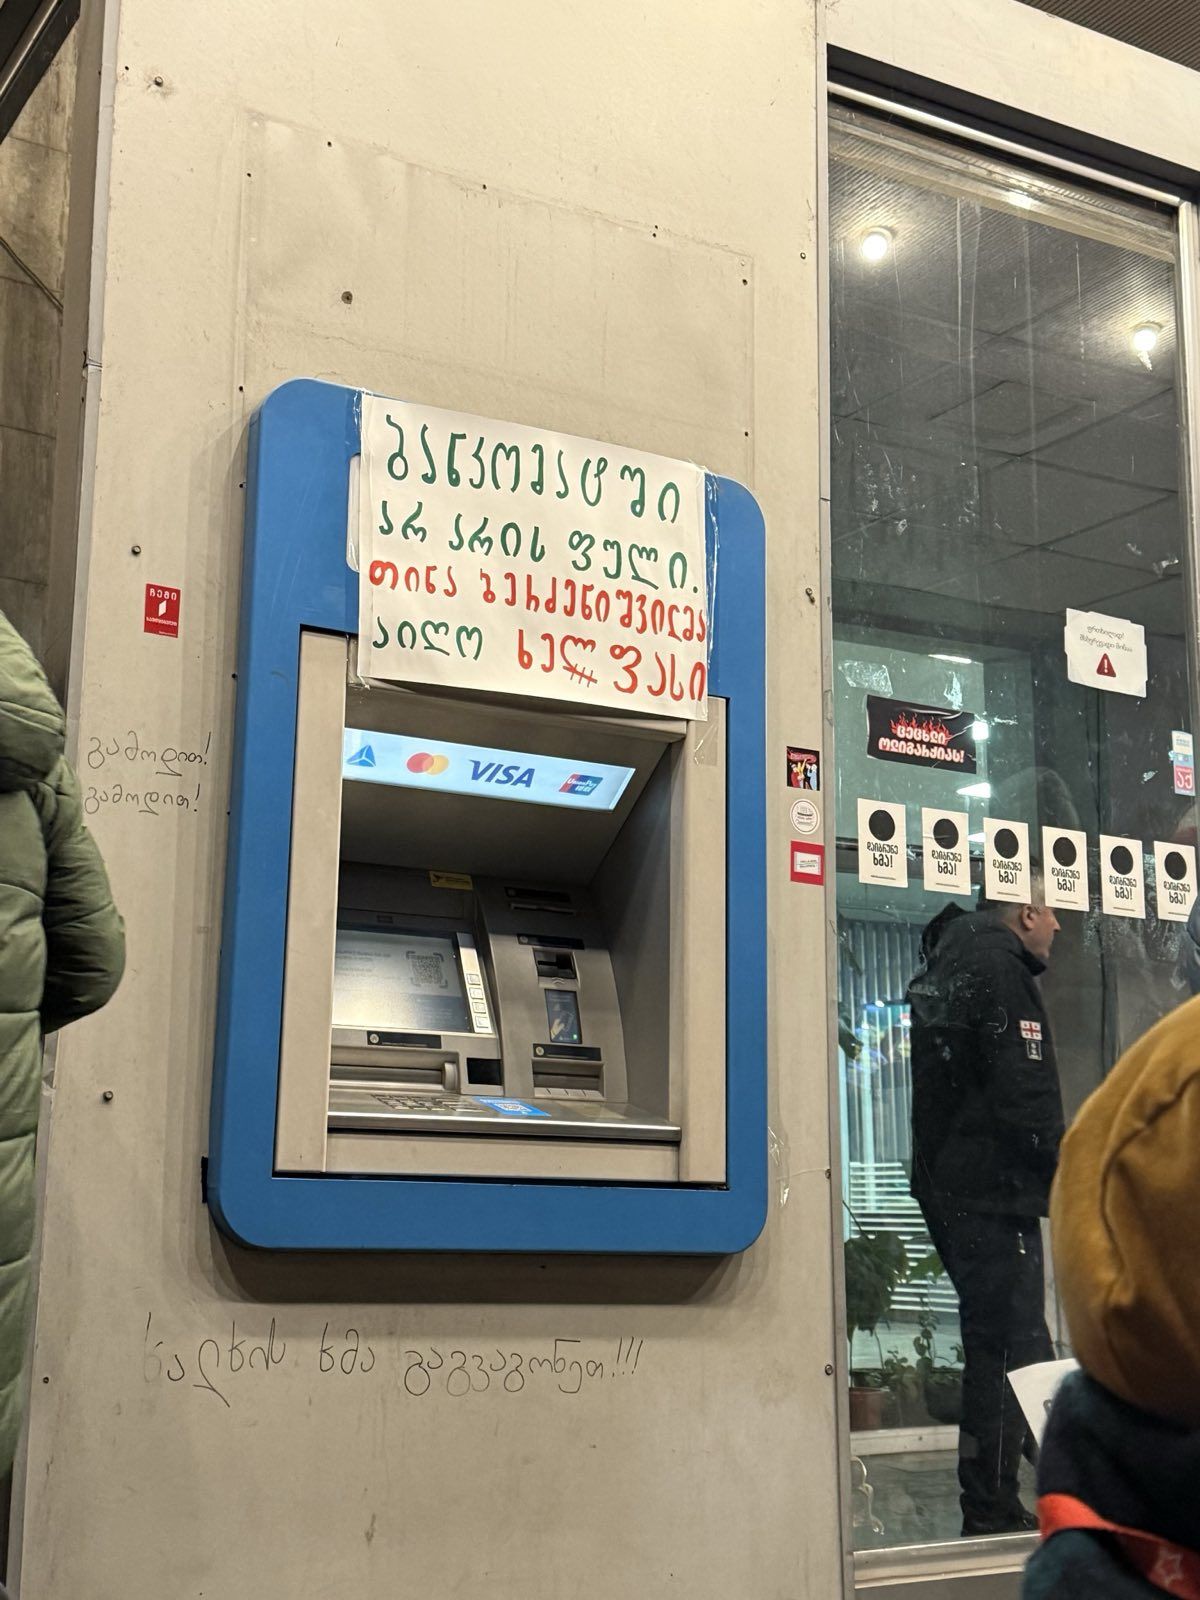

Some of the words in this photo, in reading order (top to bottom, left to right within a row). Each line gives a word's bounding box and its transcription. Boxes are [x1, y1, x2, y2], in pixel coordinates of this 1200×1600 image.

[379, 500, 427, 543] არ
[448, 513, 546, 562] არის
[568, 530, 699, 594] ფული.
[369, 560, 458, 598] თინა
[372, 616, 483, 661] აიღო
[87, 730, 212, 777] გამოდით!
[468, 759, 536, 788] VISA
[84, 783, 201, 816] გამოდით!
[872, 852, 893, 868] ხმა!
[937, 861, 957, 876] ხმა!
[998, 870, 1018, 885] ხმა!
[318, 1322, 376, 1375] ხმა
